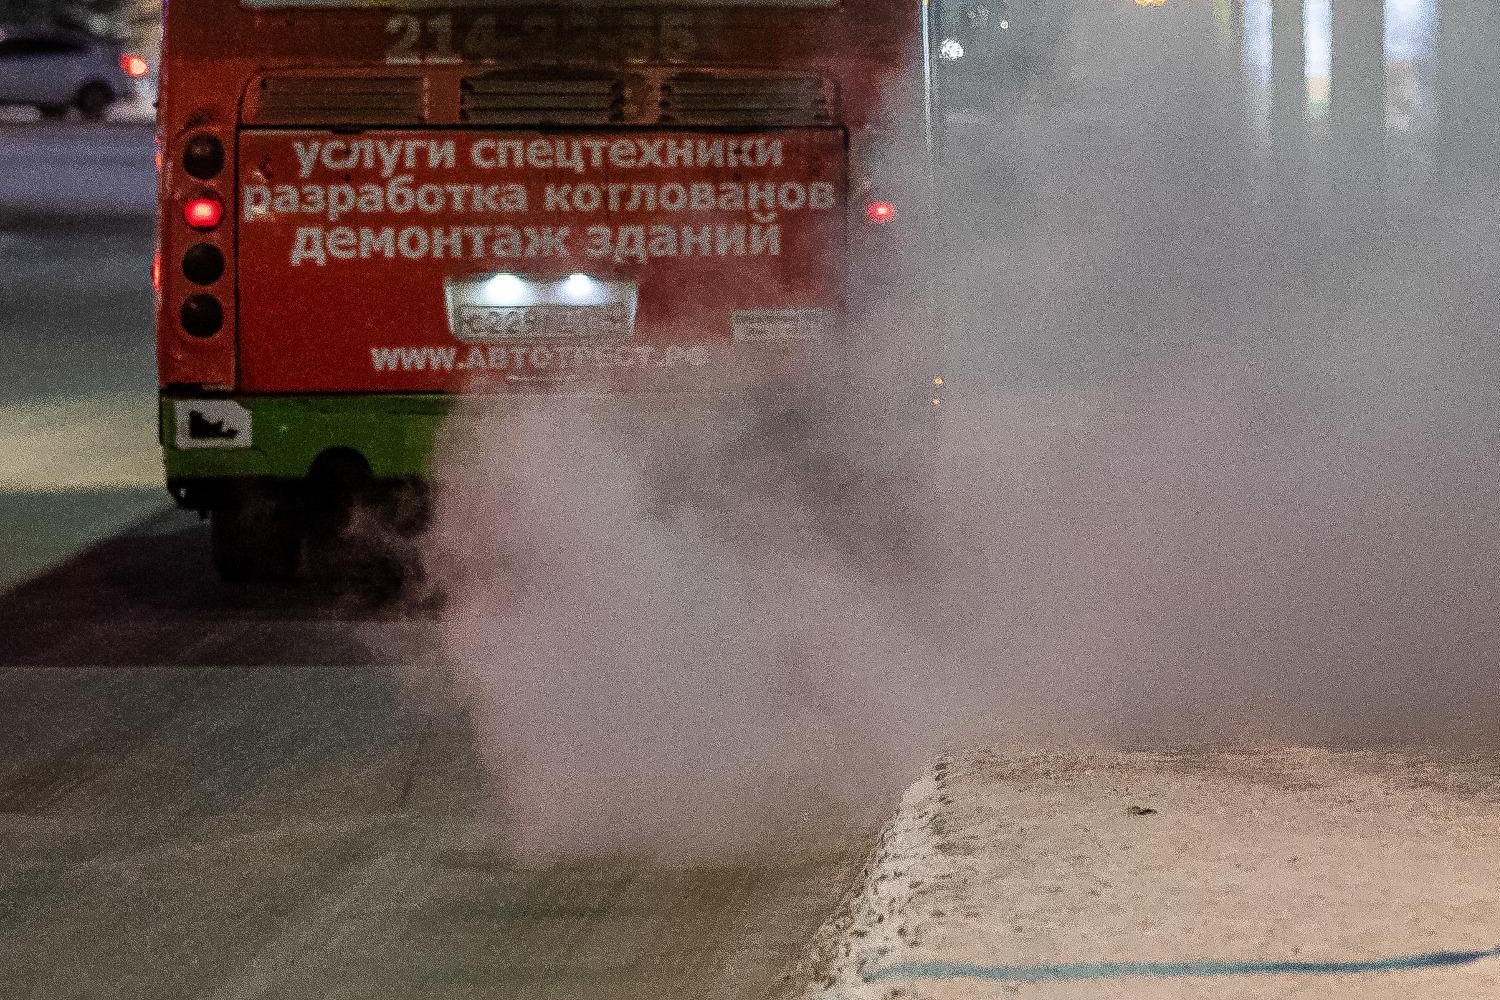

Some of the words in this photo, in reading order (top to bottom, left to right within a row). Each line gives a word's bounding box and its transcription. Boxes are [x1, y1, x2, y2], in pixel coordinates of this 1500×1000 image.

[293, 140, 456, 178] услуги
[472, 138, 784, 174] спецтехники
[243, 176, 527, 221] разработка
[545, 180, 836, 214] котлованов
[291, 222, 569, 265] демонтаж
[586, 213, 781, 264] зданий
